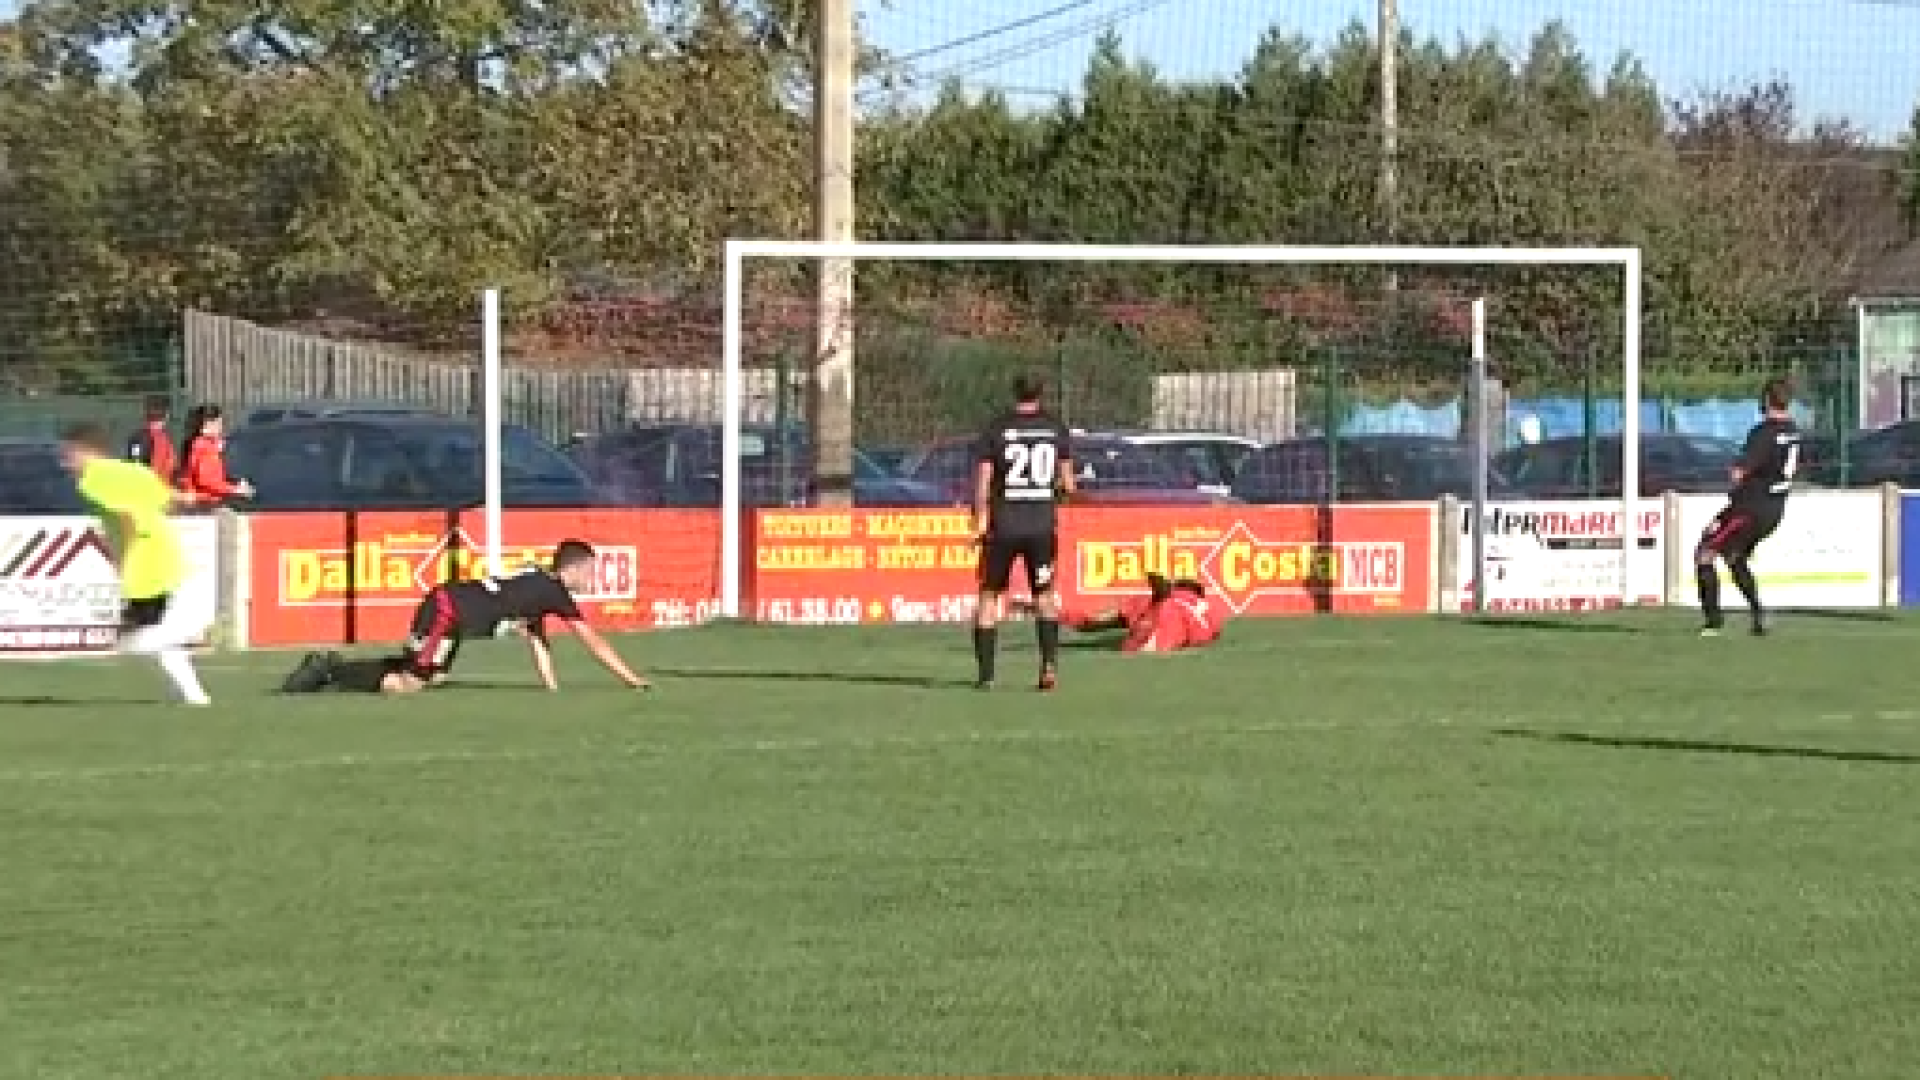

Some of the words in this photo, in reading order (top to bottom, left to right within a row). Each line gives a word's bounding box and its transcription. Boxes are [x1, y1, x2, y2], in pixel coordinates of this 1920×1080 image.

[1004, 443, 1054, 486] 20
[287, 541, 412, 600] Dalla
[1083, 534, 1198, 589] Dalla
[1221, 542, 1338, 592] Costa
[1347, 549, 1396, 589] MCB
